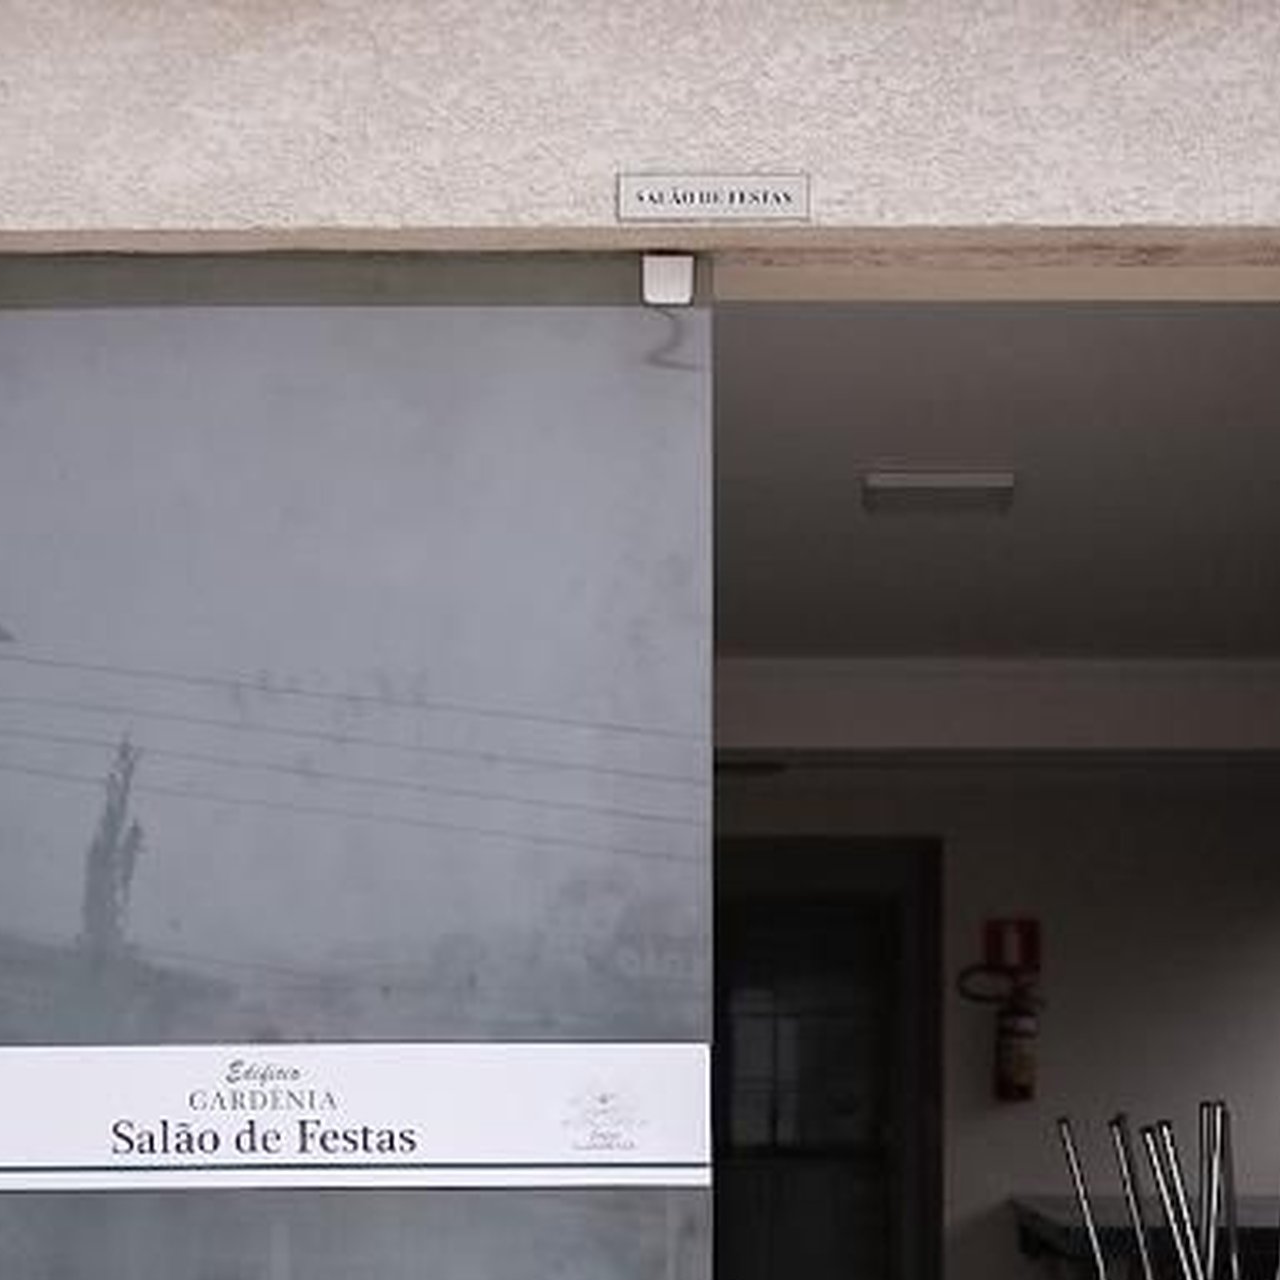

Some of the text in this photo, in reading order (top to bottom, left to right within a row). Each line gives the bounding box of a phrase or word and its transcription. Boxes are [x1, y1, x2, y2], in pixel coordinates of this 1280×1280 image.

[111, 1118, 418, 1155] Salão de Festas
